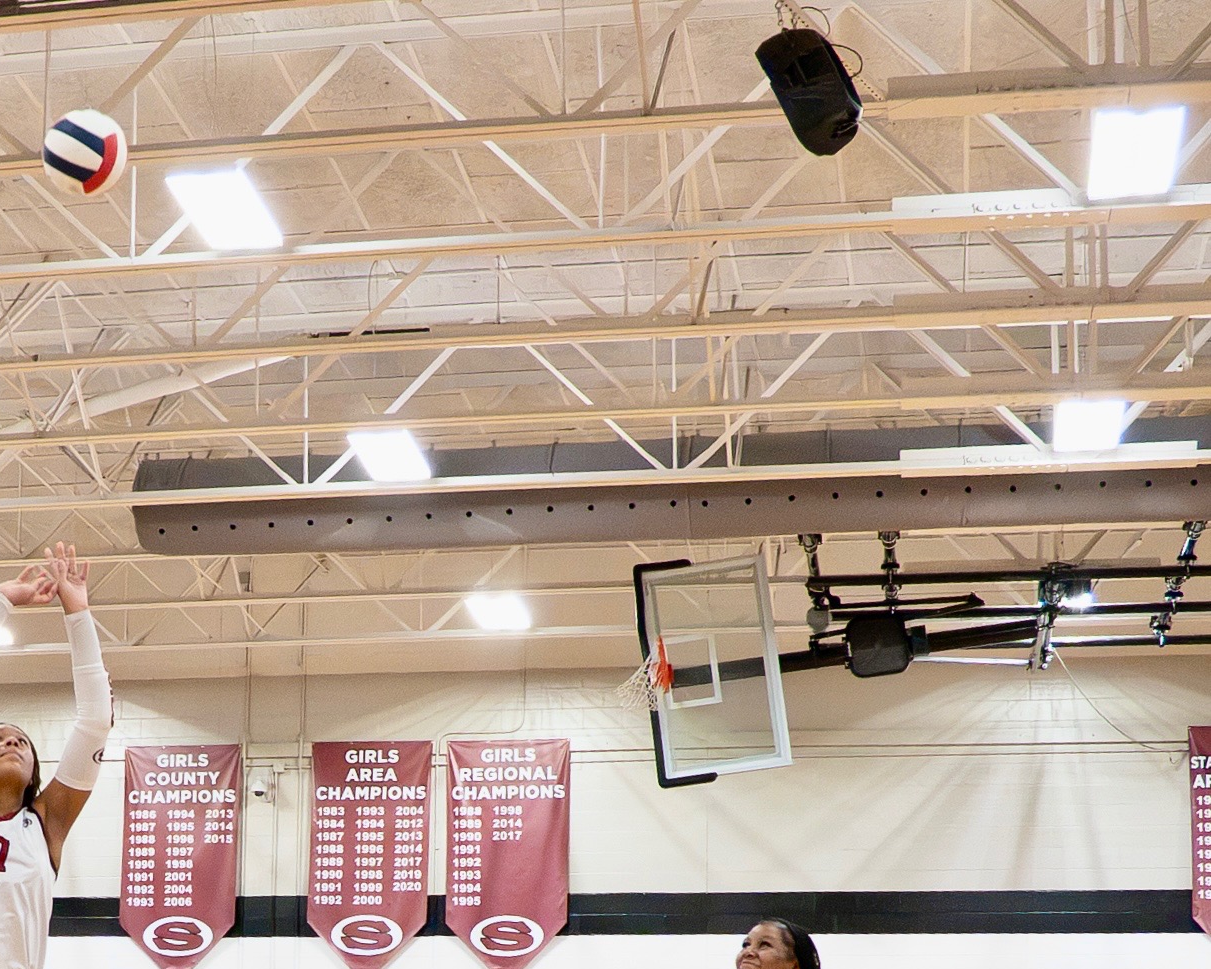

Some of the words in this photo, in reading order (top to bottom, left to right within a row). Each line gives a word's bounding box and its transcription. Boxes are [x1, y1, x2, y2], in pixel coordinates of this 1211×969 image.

[155, 753, 208, 767] GIRLS
[346, 750, 399, 763] GIRLS
[481, 748, 536, 762] GIRLS
[145, 772, 220, 785] COUNTY
[346, 768, 397, 781] AREA
[458, 766, 557, 783] REGIONAL
[129, 789, 236, 804] CHAMPIONS
[316, 786, 426, 800] CHAMPIONS
[452, 784, 565, 801] CHAMPIONS
[167, 810, 194, 819] 1994
[205, 809, 233, 818] 2013
[318, 807, 344, 816] 1983
[356, 807, 384, 815] 1993
[396, 806, 424, 815] 2004
[130, 822, 156, 832] 1987
[167, 822, 194, 831] 1995
[204, 822, 233, 831] 2014
[316, 820, 344, 828] 1984
[356, 819, 384, 828] 1994
[395, 819, 423, 828] 2012
[493, 819, 522, 828] 2014
[166, 835, 194, 843] 1996
[204, 834, 233, 843] 2015
[316, 832, 344, 841] 1987
[355, 832, 384, 841] 1995
[395, 831, 423, 841] 2013
[453, 832, 482, 841] 1990
[493, 831, 522, 840] 2017
[166, 847, 193, 856] 1997
[355, 844, 383, 853] 1996
[394, 844, 423, 853] 2014
[453, 845, 480, 854] 1991
[128, 860, 155, 869] 1990
[355, 857, 383, 866] 1997
[394, 857, 422, 866] 2017
[453, 858, 481, 867] 1992
[128, 872, 153, 881] 1991
[165, 872, 191, 881] 2001
[315, 870, 343, 879] 1990
[394, 870, 422, 879] 2019
[453, 870, 481, 880] 1993
[127, 885, 154, 894] 1992
[164, 885, 192, 894] 2004
[315, 883, 341, 892] 1991
[354, 883, 382, 892] 1999
[393, 882, 421, 891] 2020
[453, 883, 481, 893] 1994
[126, 897, 154, 906] 1993
[164, 897, 192, 906] 2006
[314, 895, 342, 904] 1992
[353, 896, 382, 904] 2000
[452, 896, 481, 906] 1995
